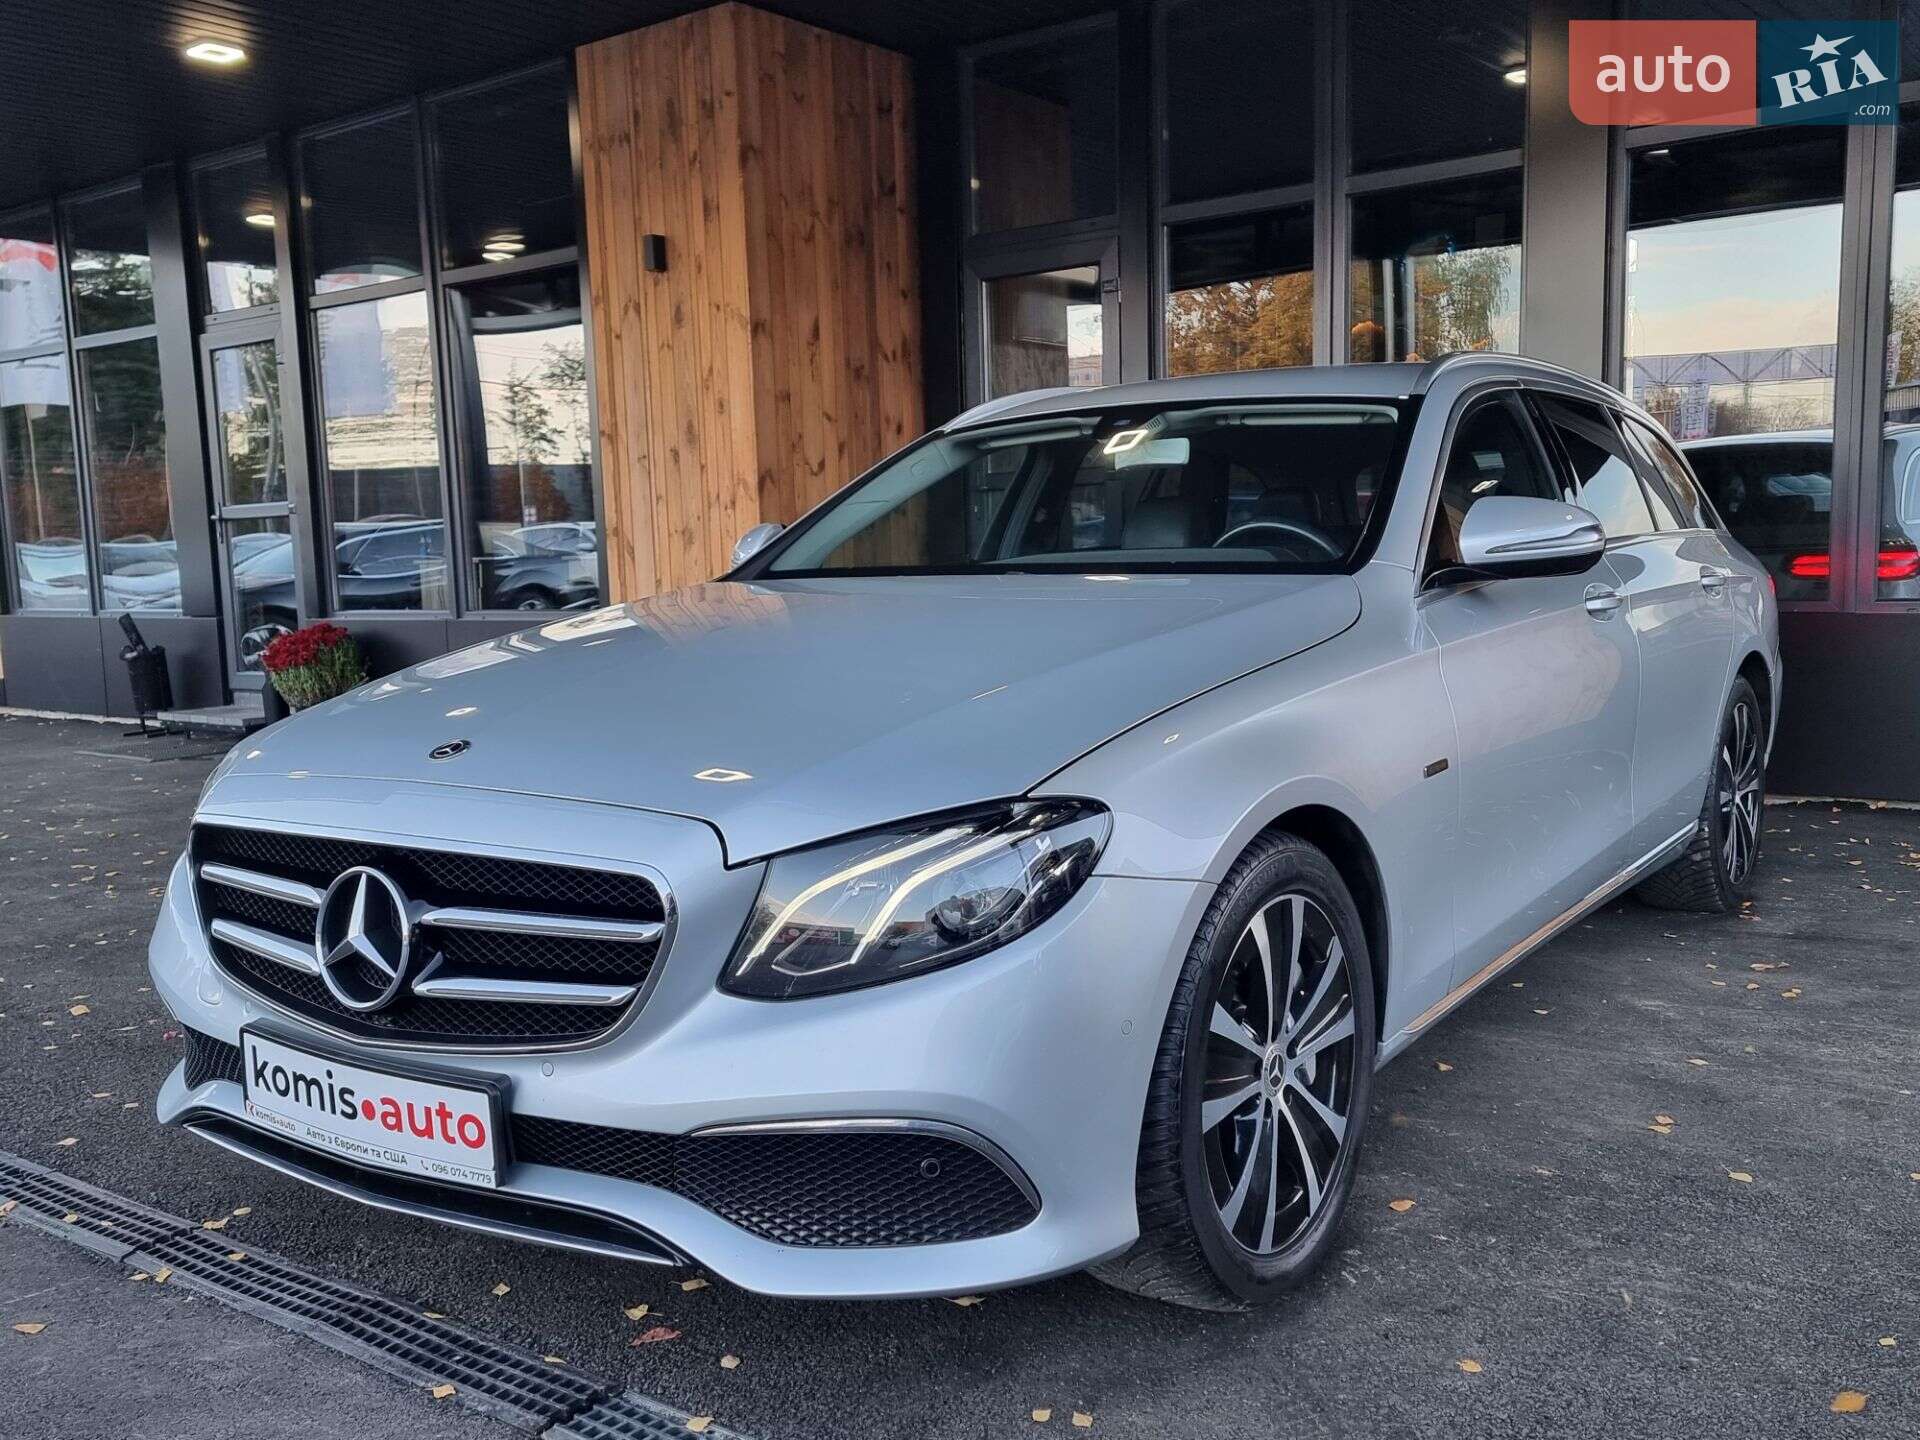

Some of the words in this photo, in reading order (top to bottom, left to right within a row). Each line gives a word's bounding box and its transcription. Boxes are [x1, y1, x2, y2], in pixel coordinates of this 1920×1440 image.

[306, 1127, 326, 1143] Авто
[334, 1134, 369, 1155] Європи
[371, 1148, 381, 1158] та
[383, 1150, 408, 1166] США
[451, 1167, 468, 1179] 074
[469, 1170, 492, 1184] 7779
